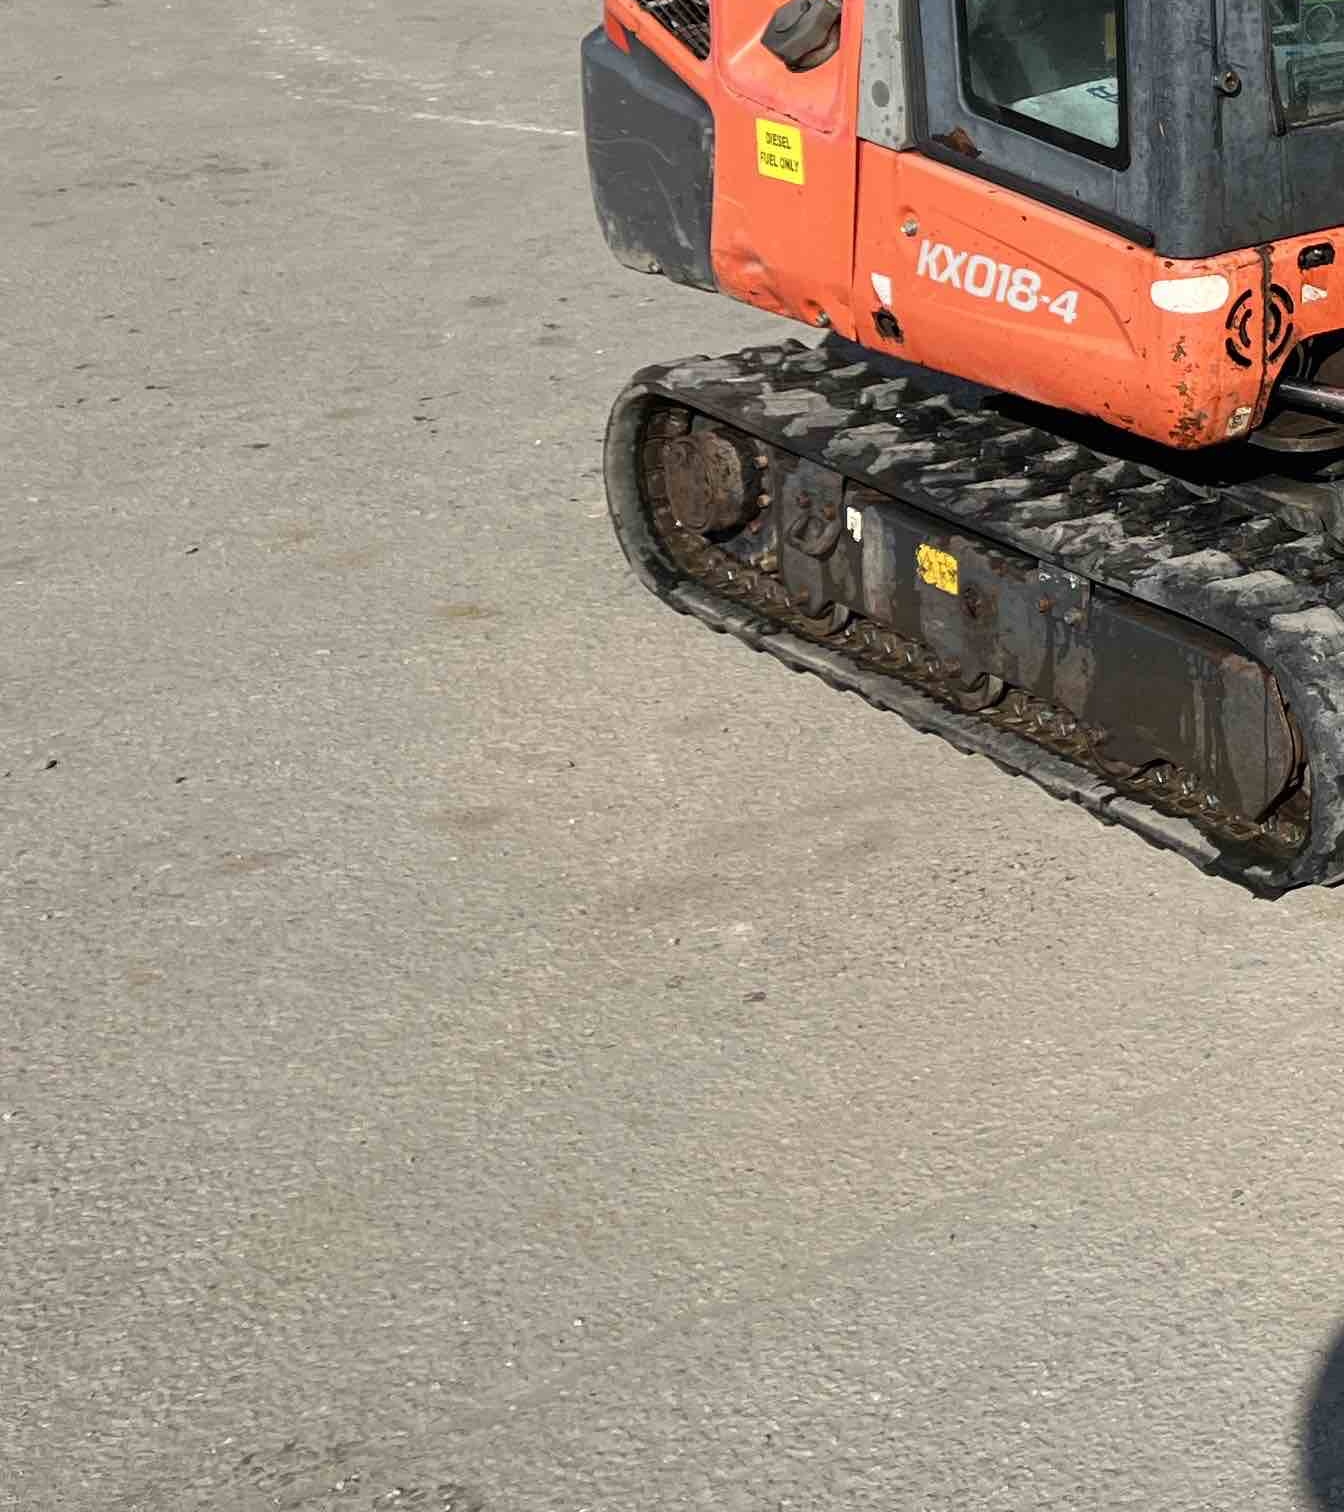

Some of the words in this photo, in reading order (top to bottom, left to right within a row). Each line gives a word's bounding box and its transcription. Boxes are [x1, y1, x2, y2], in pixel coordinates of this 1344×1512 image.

[765, 131, 792, 150] DIESEL
[760, 151, 778, 168] FUEL
[780, 157, 799, 173] ONLY
[916, 238, 1079, 324] KX018-4
